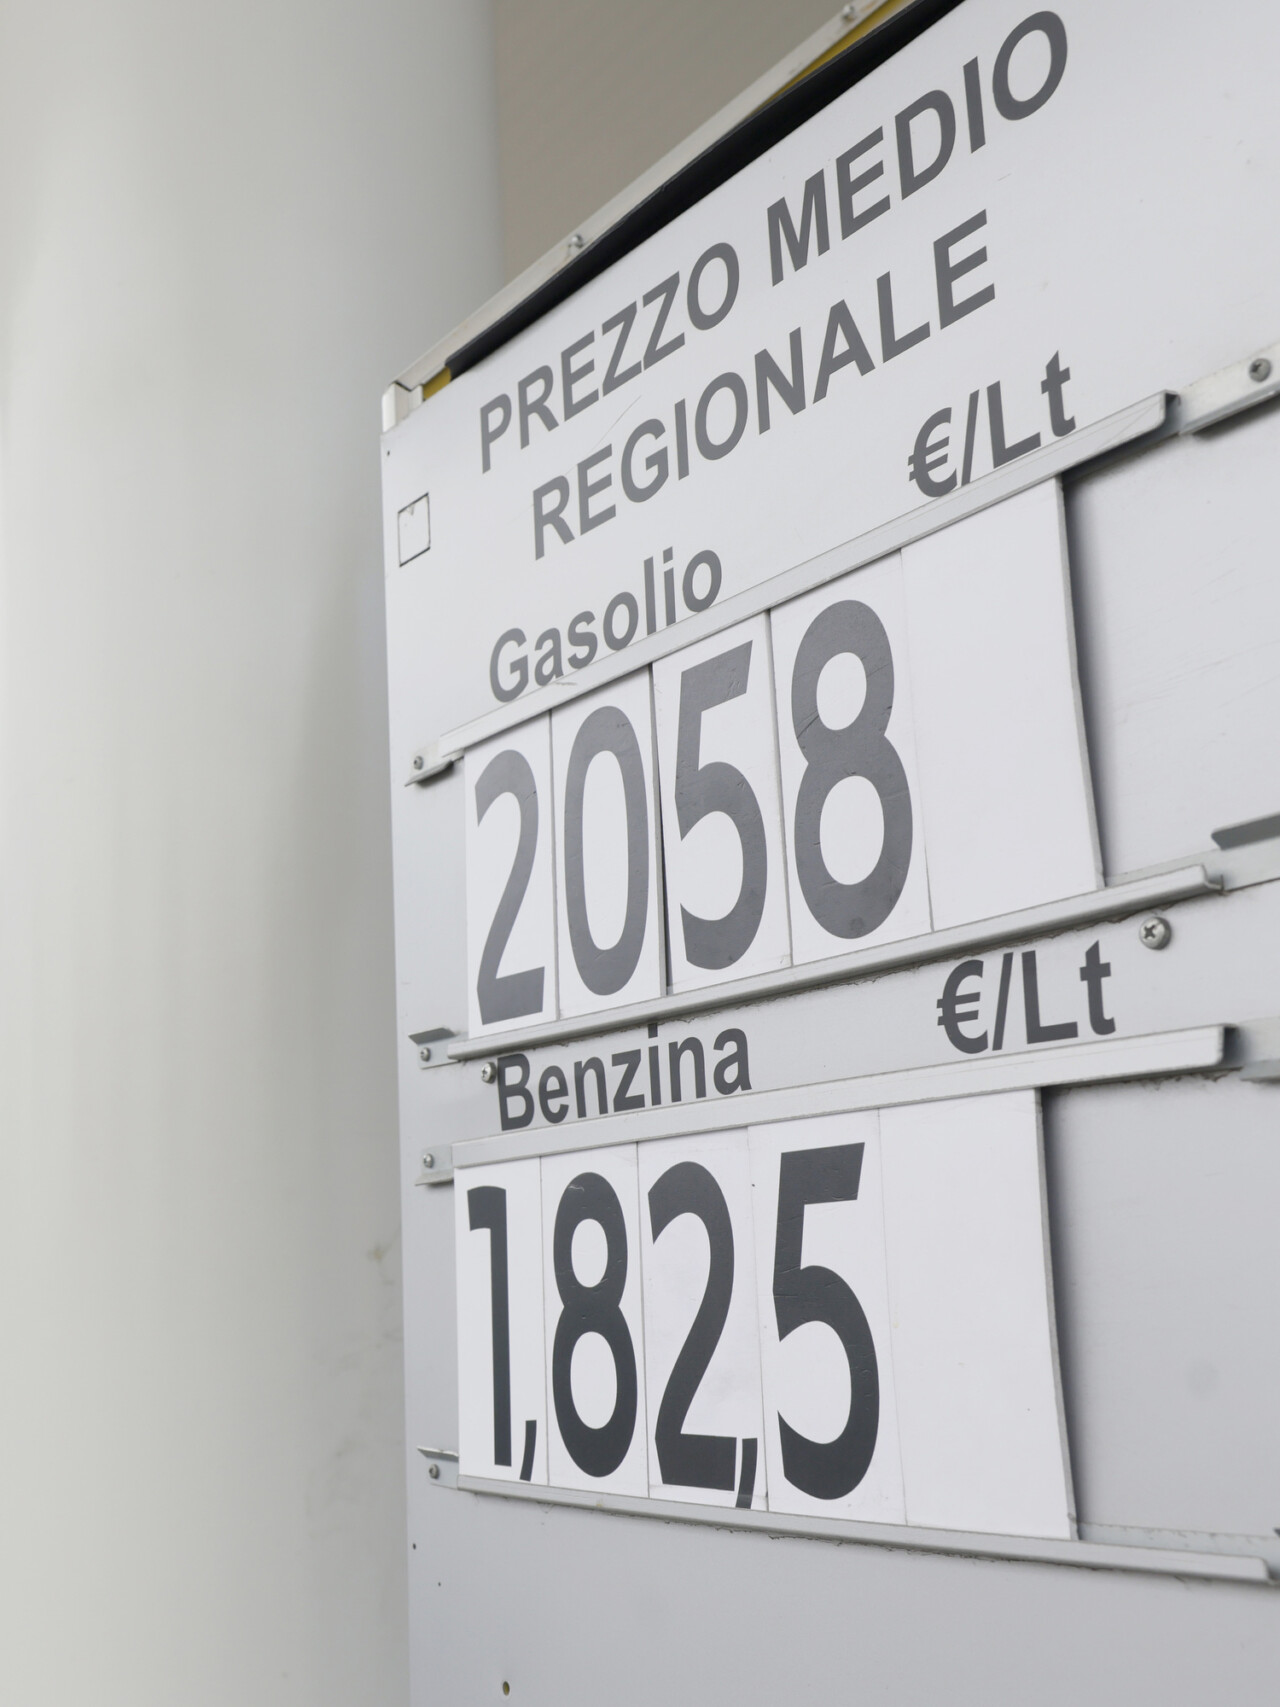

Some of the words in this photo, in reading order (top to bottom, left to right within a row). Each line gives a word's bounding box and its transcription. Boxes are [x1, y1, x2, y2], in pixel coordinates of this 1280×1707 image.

[480, 242, 740, 475] PREZZO
[767, 10, 1068, 286] MEDIO
[532, 209, 997, 560] REGIONALE
[908, 350, 1077, 498] €/Lt
[489, 547, 723, 702] Gasolio
[473, 599, 914, 1025] 2058
[936, 940, 1117, 1054] €/Lt
[495, 1023, 752, 1131] Benzina
